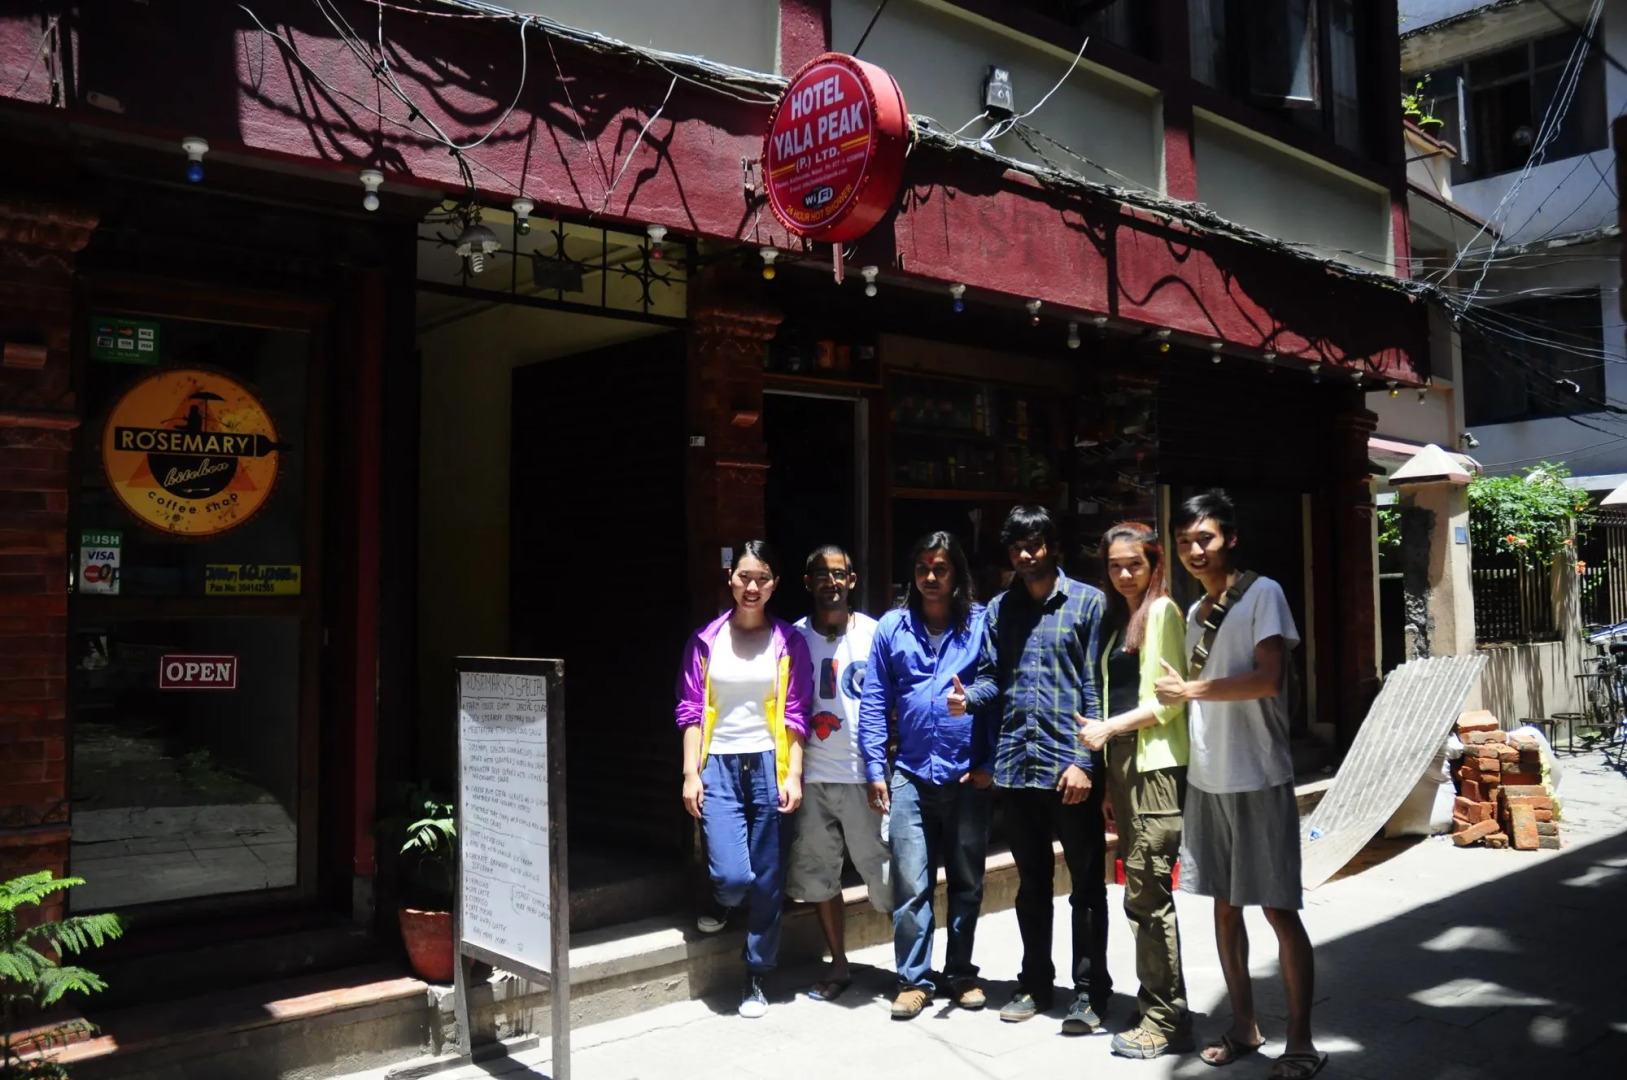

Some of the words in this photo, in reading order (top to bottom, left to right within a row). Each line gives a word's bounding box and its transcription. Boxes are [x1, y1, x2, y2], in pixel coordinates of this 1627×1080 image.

[791, 74, 844, 121] HOTEL
[774, 122, 813, 161] YALA
[818, 101, 864, 145] PEAK
[815, 146, 840, 164] LTD.
[793, 208, 810, 222] HOUR
[811, 209, 824, 222] HOT
[825, 183, 853, 216] SHOWER
[148, 490, 197, 514] coffee
[205, 492, 239, 513] shop
[81, 535, 120, 545] PUSH
[88, 551, 115, 560] VISA
[165, 662, 232, 682] OPEN
